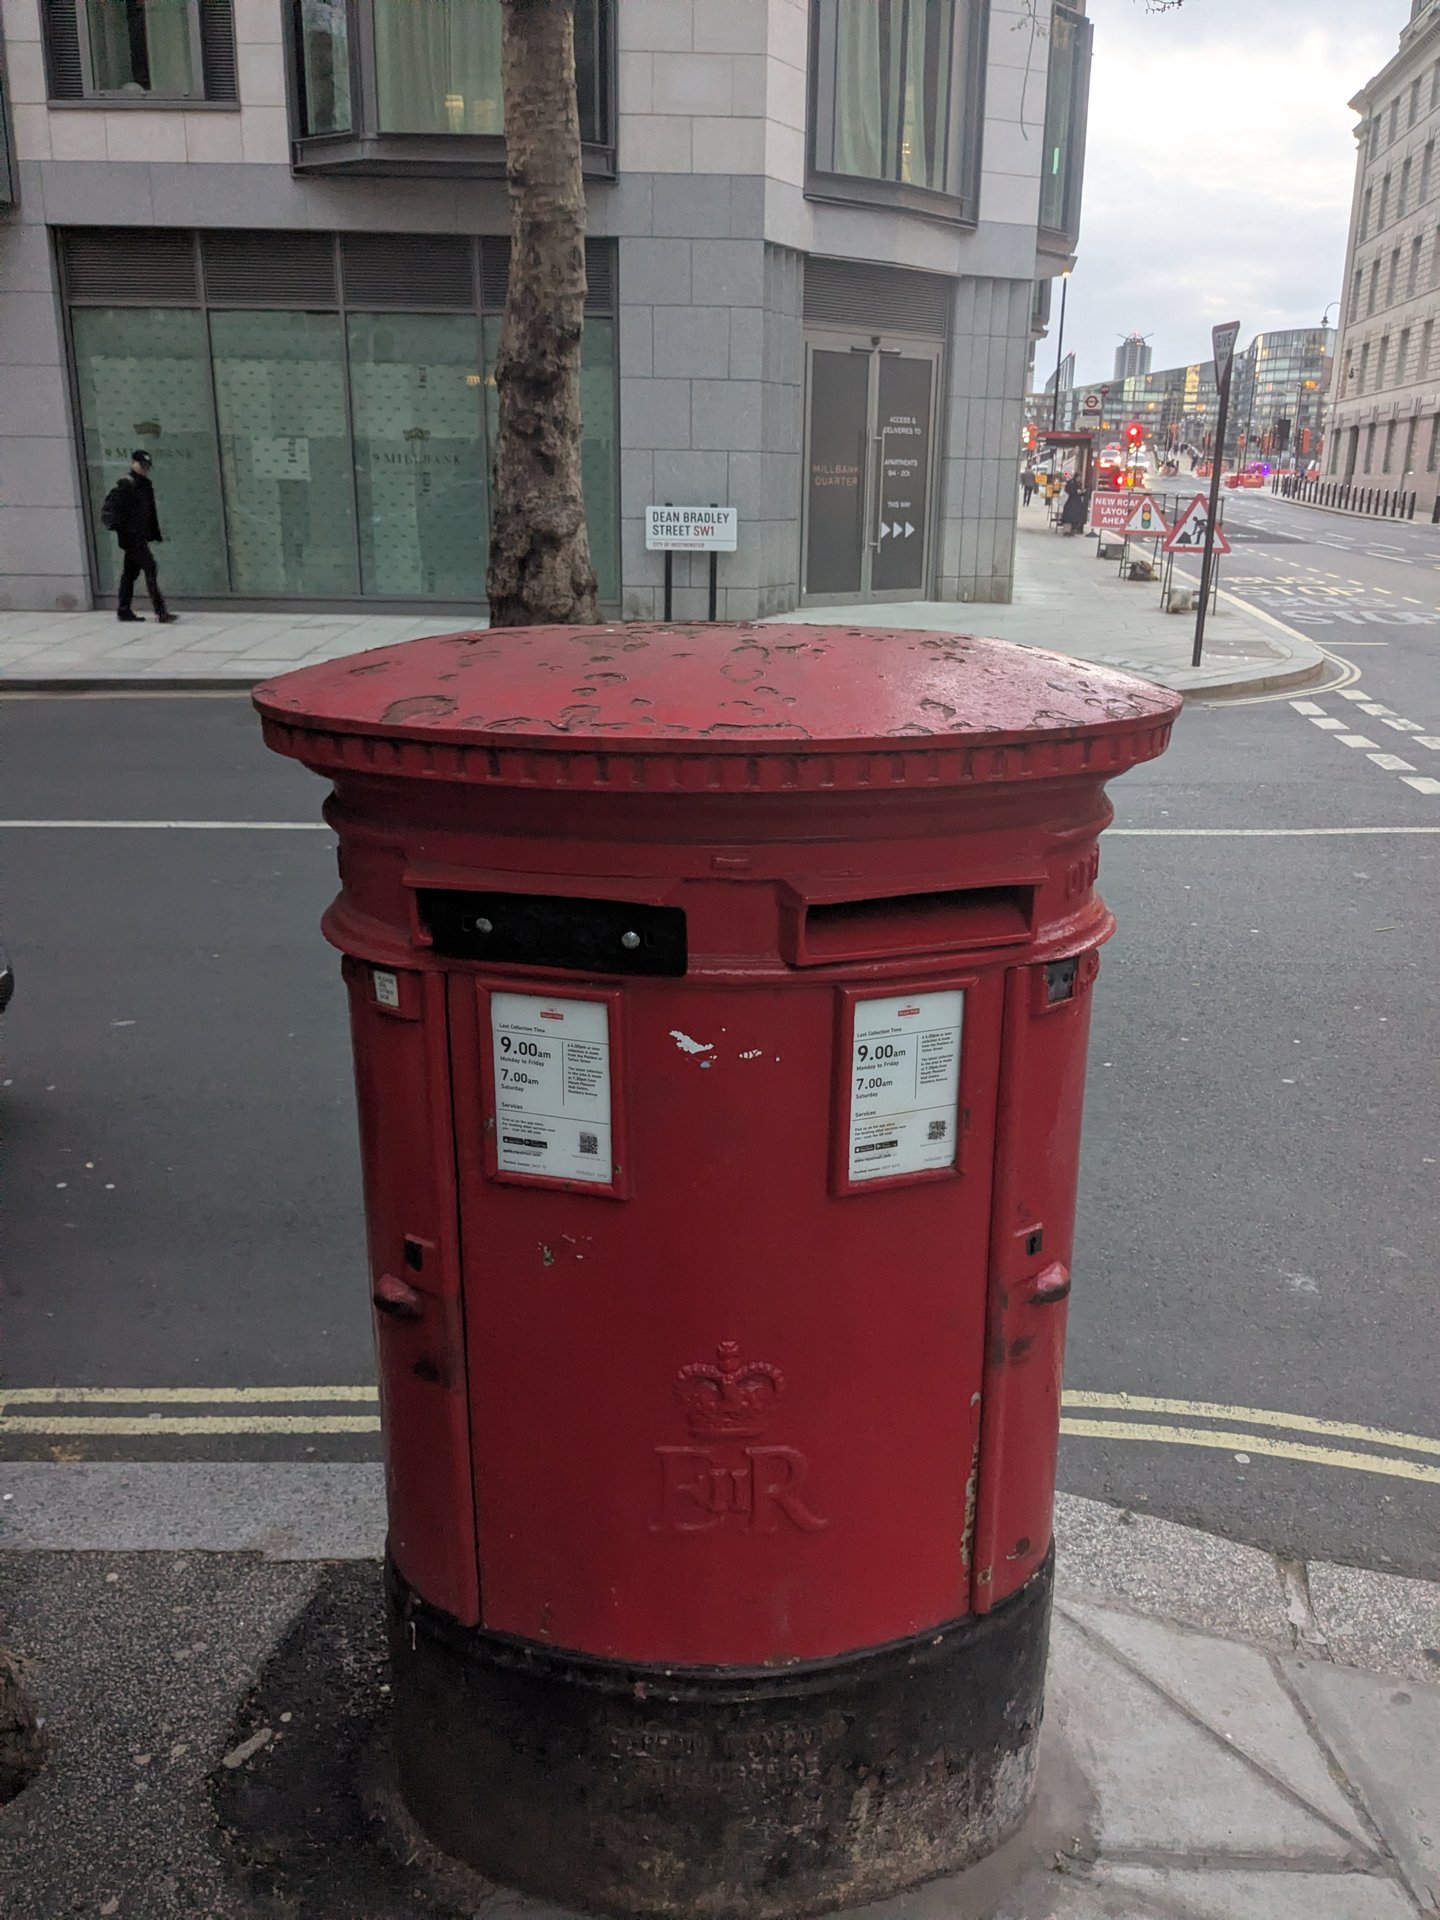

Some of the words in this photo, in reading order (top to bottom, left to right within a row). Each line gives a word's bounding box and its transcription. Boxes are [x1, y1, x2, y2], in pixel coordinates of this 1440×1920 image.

[815, 476, 858, 487] QUARTER
[1095, 497, 1116, 506] NEW
[652, 511, 680, 523] DEAN
[683, 512, 730, 524] BRADLEY
[1101, 508, 1128, 516] LAYOU
[1102, 517, 1125, 525] AHEA
[652, 525, 691, 536] STREET
[693, 526, 715, 537] SW1
[1230, 586, 1366, 596] STOP
[1281, 610, 1440, 625] STOP
[500, 1036, 551, 1059] 9.00am
[857, 1045, 906, 1062] 9.00am
[500, 1068, 539, 1085] 7.00am
[501, 1084, 524, 1092] Saturday
[856, 1077, 893, 1090] 7.00am
[856, 1092, 878, 1100] Saturday
[502, 1102, 523, 1110] Services
